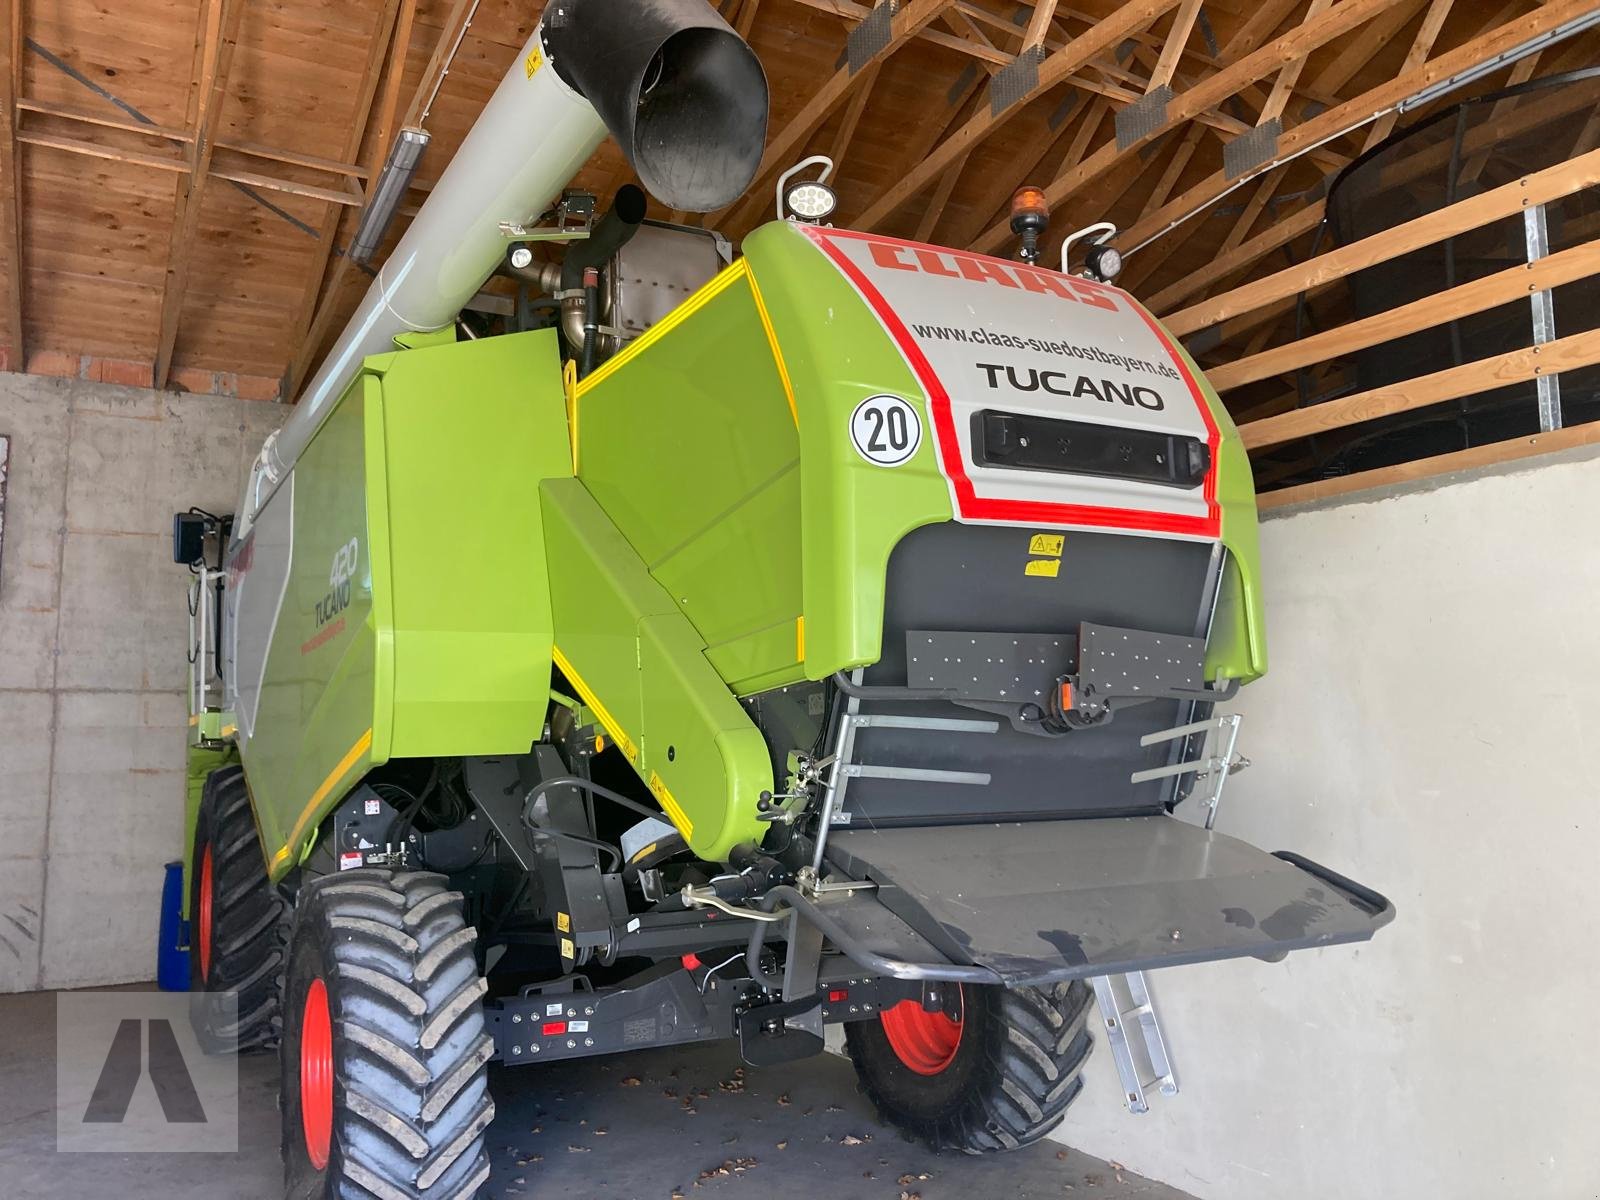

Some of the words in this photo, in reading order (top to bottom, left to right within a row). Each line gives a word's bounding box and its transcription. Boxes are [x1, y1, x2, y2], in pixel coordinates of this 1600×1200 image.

[867, 242, 1120, 313] CLAAS
[911, 323, 1180, 381] www.claas-suedostbayern.de
[976, 362, 1165, 412] TUCANO
[863, 406, 909, 452] 20
[329, 536, 358, 588] 420
[315, 579, 350, 628] TUCANO
